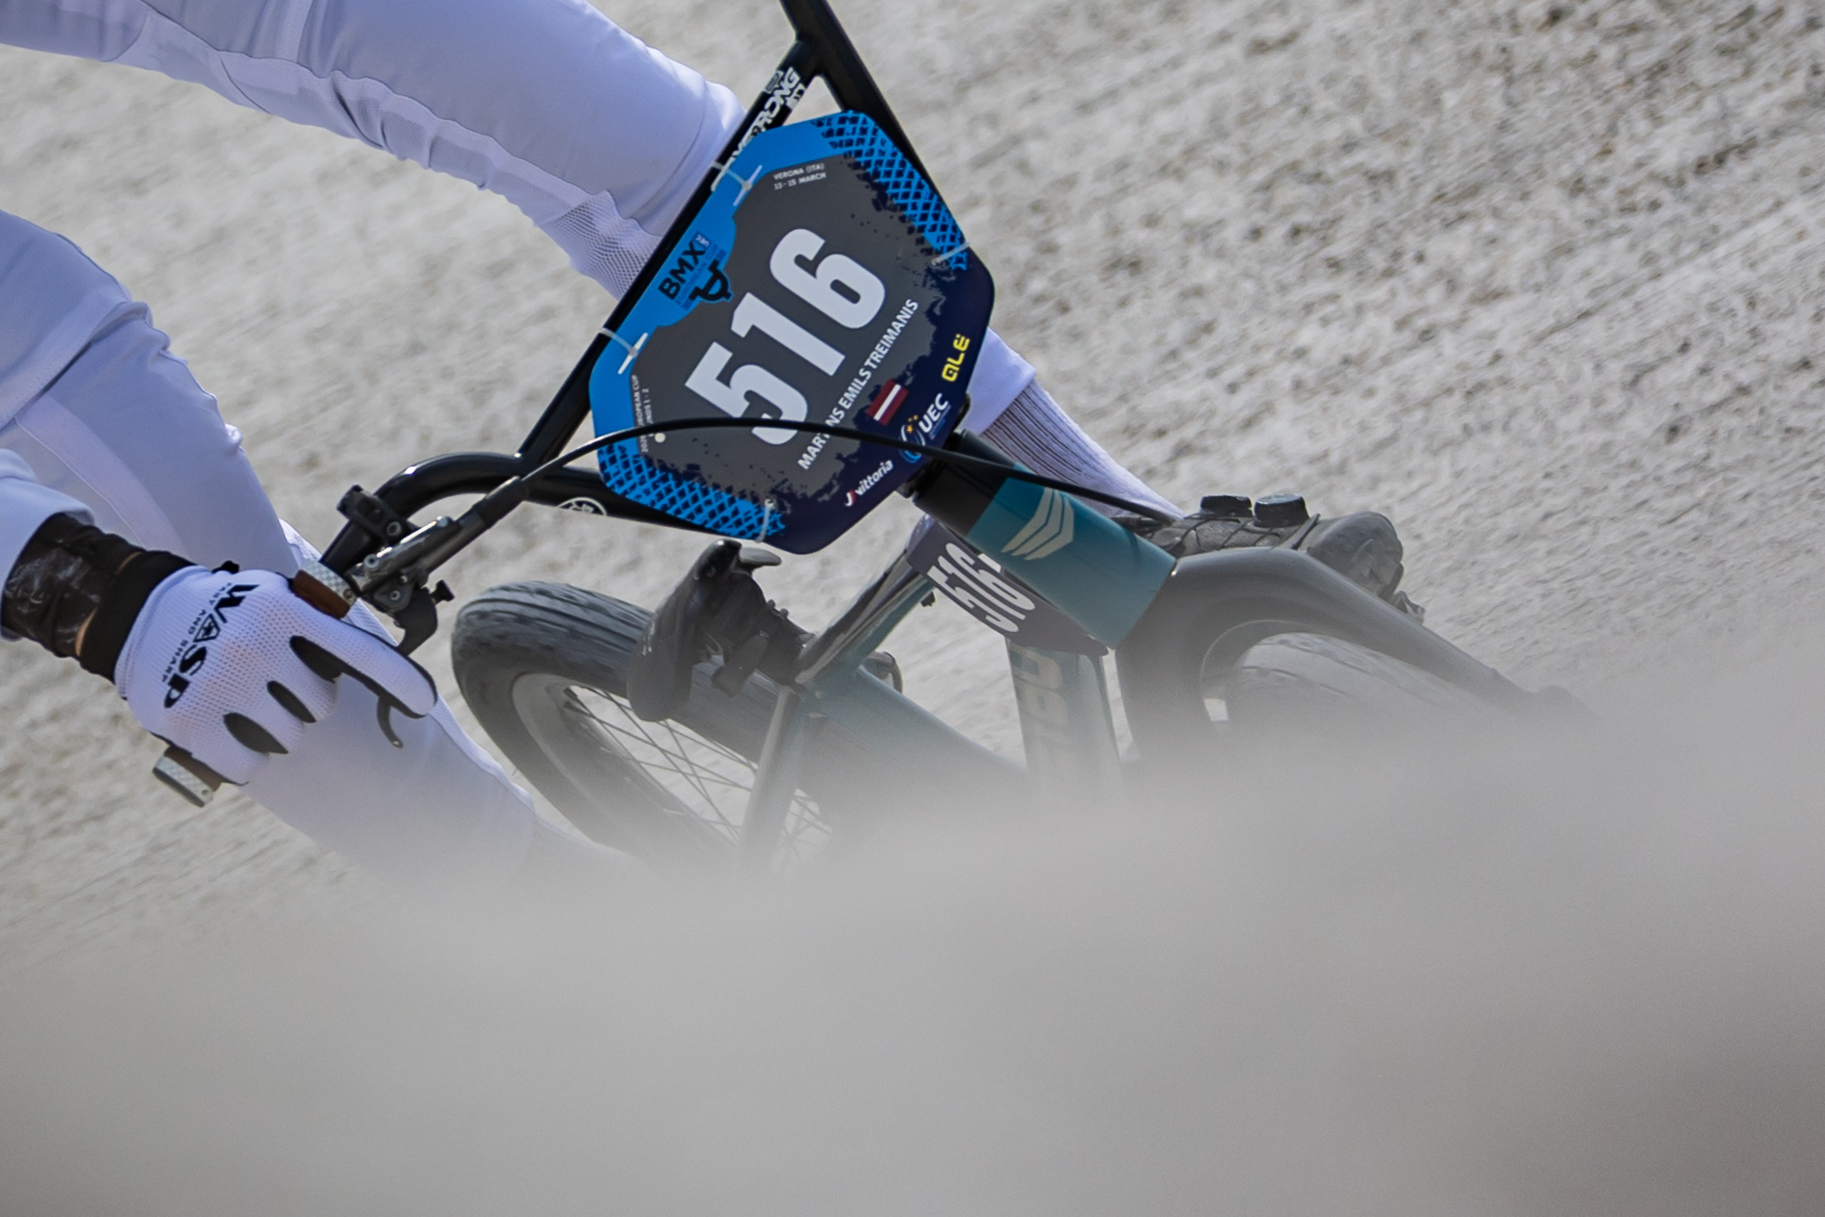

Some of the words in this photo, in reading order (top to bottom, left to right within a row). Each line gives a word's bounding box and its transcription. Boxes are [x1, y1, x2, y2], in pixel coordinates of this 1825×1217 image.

[773, 167, 805, 180] VERONA
[798, 172, 827, 184] MARCH
[657, 239, 706, 300] BMX
[685, 228, 886, 446] 516
[797, 406, 846, 471] MARTNS
[838, 366, 873, 410] EMILS
[864, 297, 919, 373] TREIMANIS
[917, 392, 951, 434] UEC
[854, 458, 894, 497] vittoria
[926, 541, 1036, 633] 516
[187, 608, 208, 636] AND
[160, 639, 189, 684] SHARP
[163, 583, 260, 709] WASP
